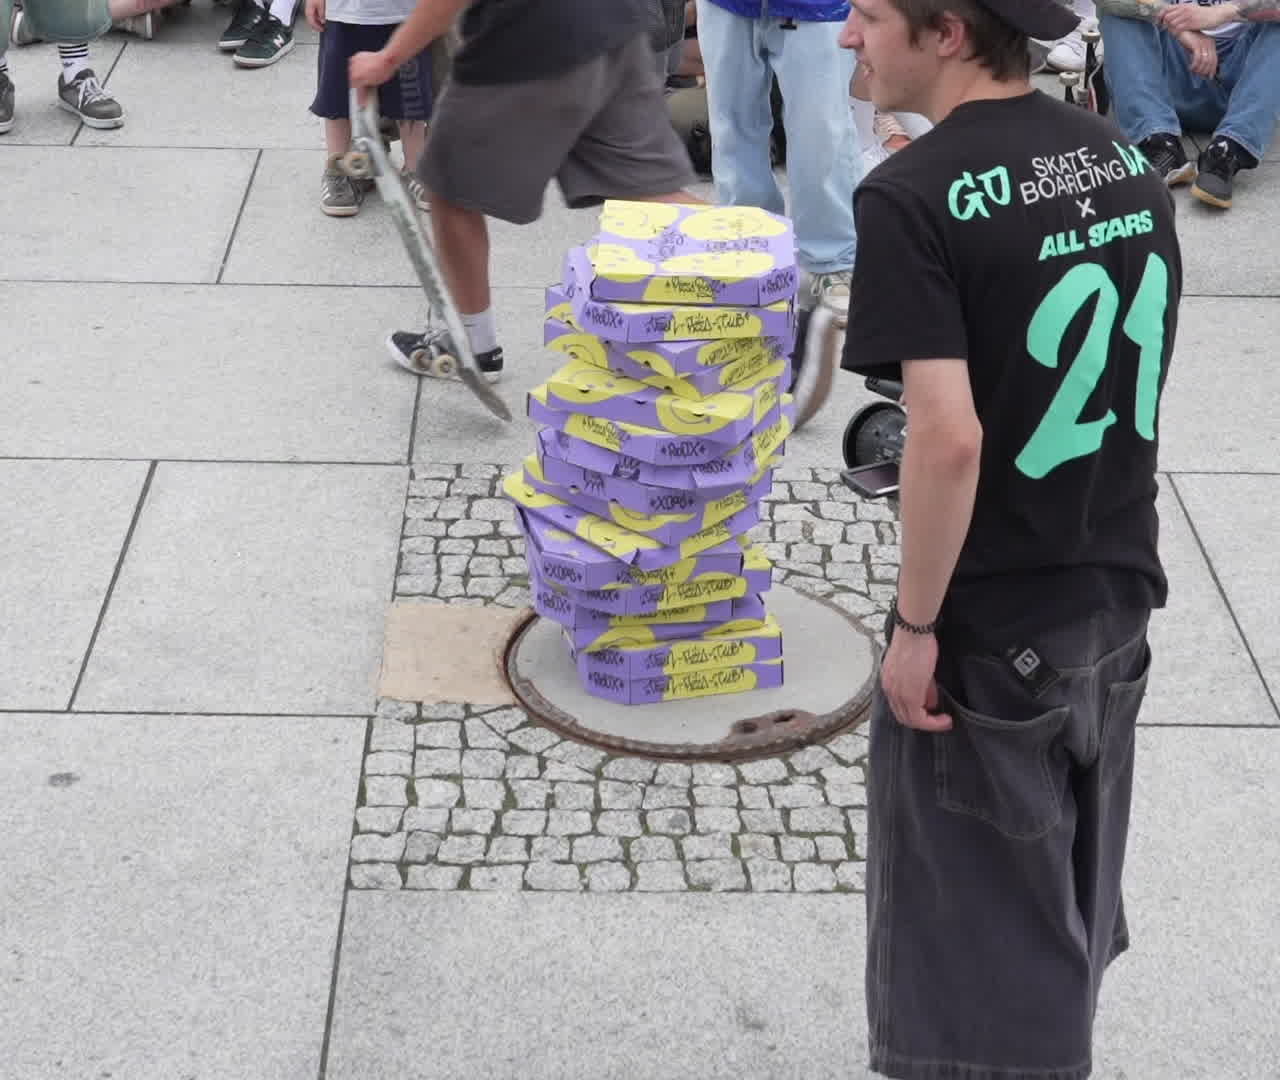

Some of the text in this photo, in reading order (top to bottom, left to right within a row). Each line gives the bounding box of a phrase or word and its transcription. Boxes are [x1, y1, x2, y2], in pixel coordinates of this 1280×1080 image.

[1032, 147, 1097, 177] SKATE-
[948, 165, 1011, 221] GO
[1038, 210, 1153, 261] ALL STARS
[1014, 252, 1169, 480] 21
